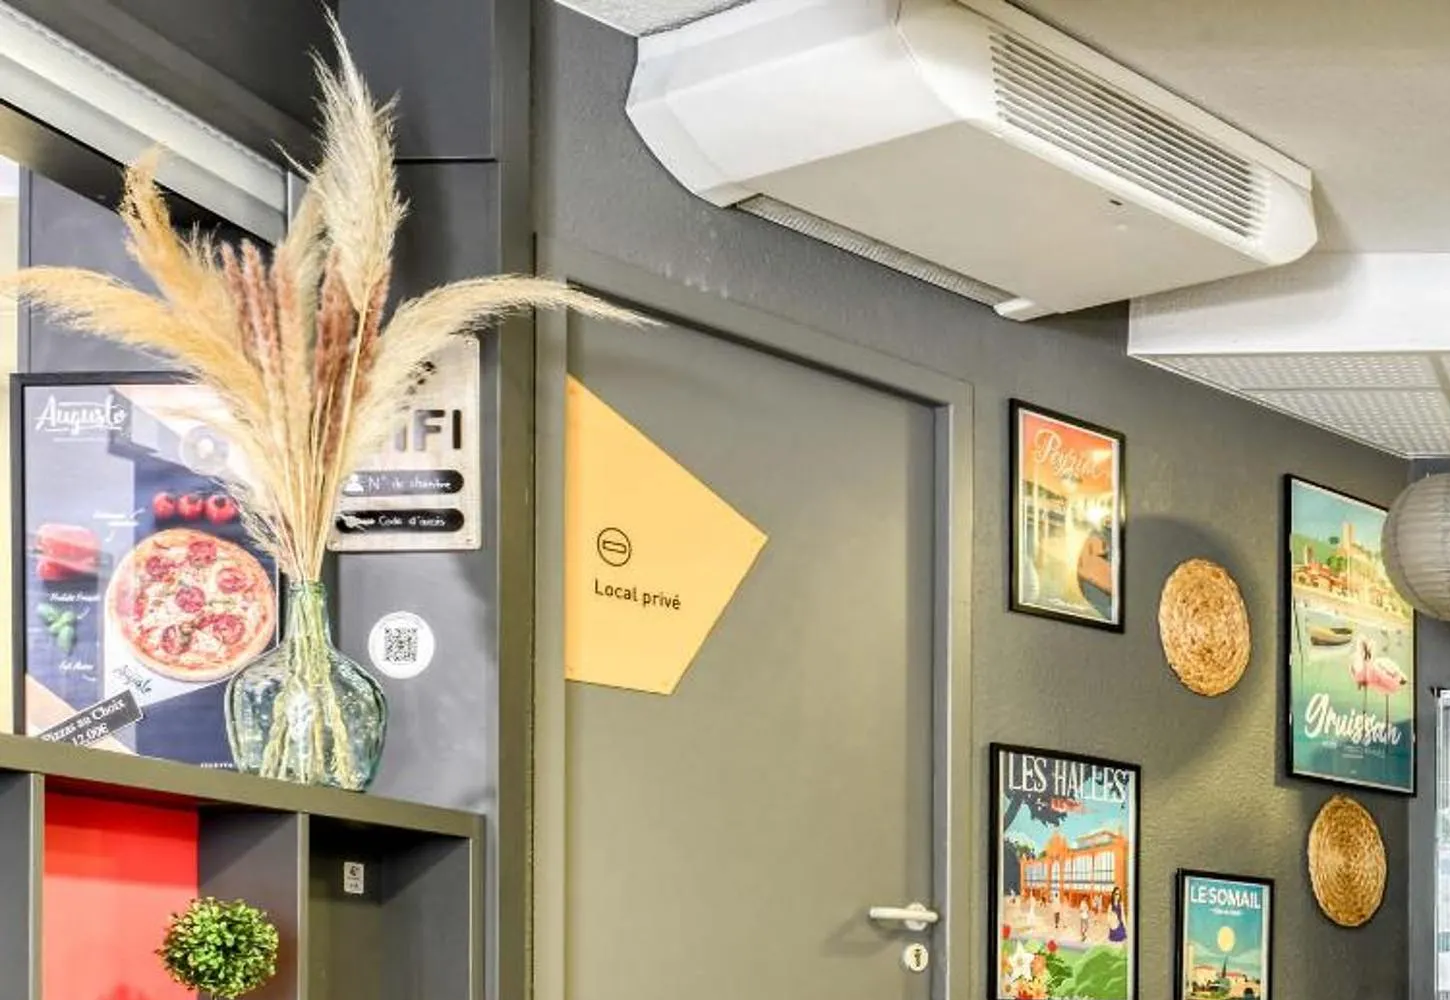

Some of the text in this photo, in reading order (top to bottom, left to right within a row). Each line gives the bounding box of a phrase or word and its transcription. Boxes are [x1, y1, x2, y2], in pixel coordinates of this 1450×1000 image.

[34, 395, 126, 436] Augusto
[595, 578, 681, 610] Local privé
[1008, 751, 1126, 803] LES HALLES
